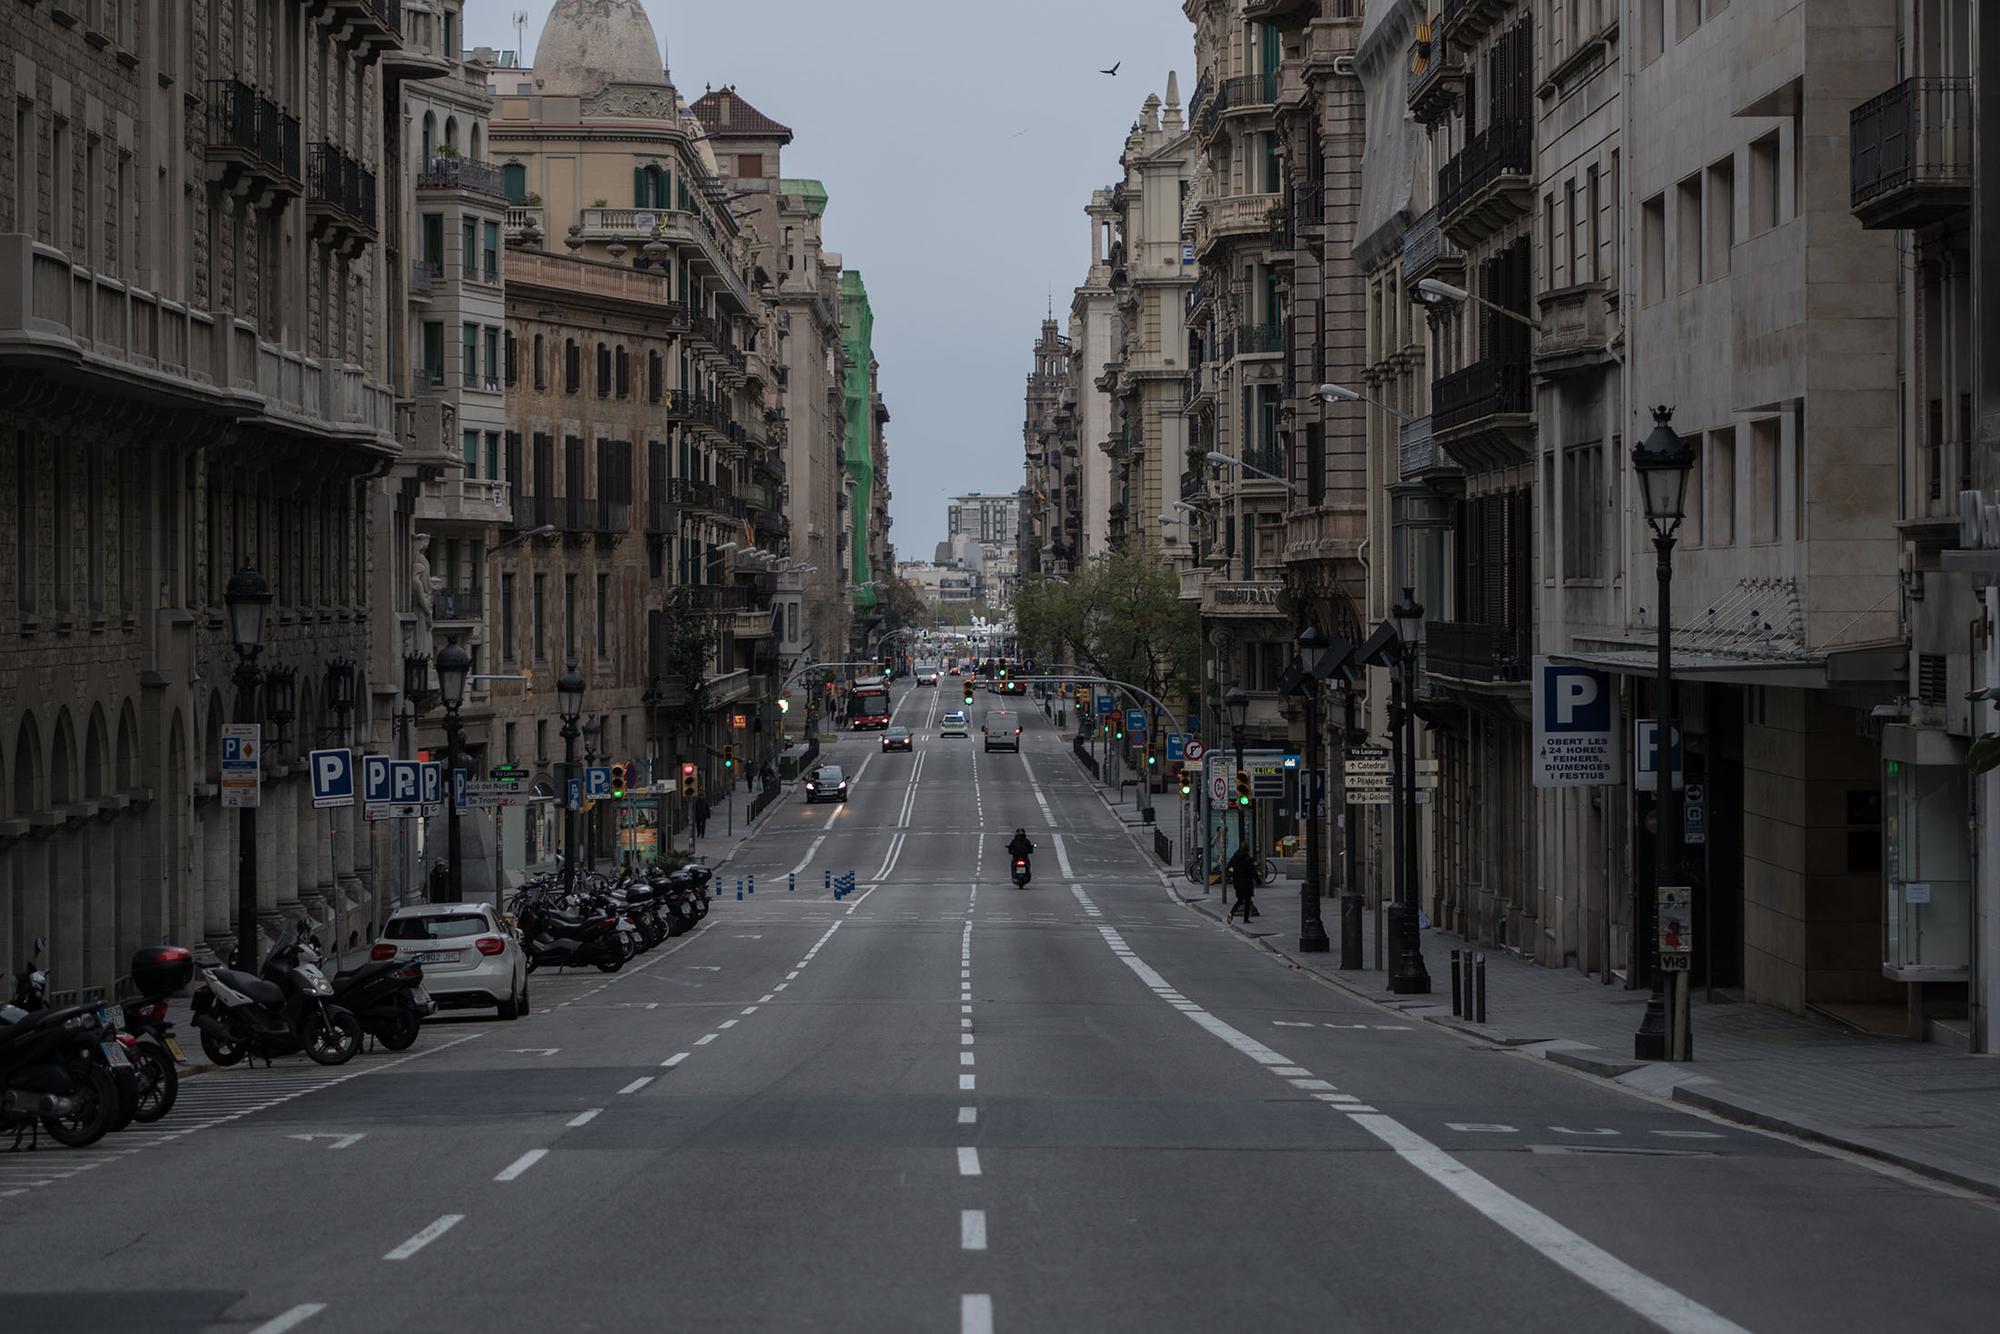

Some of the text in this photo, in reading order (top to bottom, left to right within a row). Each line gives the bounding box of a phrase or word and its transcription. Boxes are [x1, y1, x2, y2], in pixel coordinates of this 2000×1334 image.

[1557, 675, 1598, 723] P
[226, 739, 236, 759] P
[1553, 755, 1602, 763] FEINERS,
[319, 756, 344, 792] P
[370, 762, 385, 795] P
[395, 766, 415, 798] P
[425, 768, 437, 798] P
[590, 771, 606, 794] P
[1357, 777, 1384, 785] Platges
